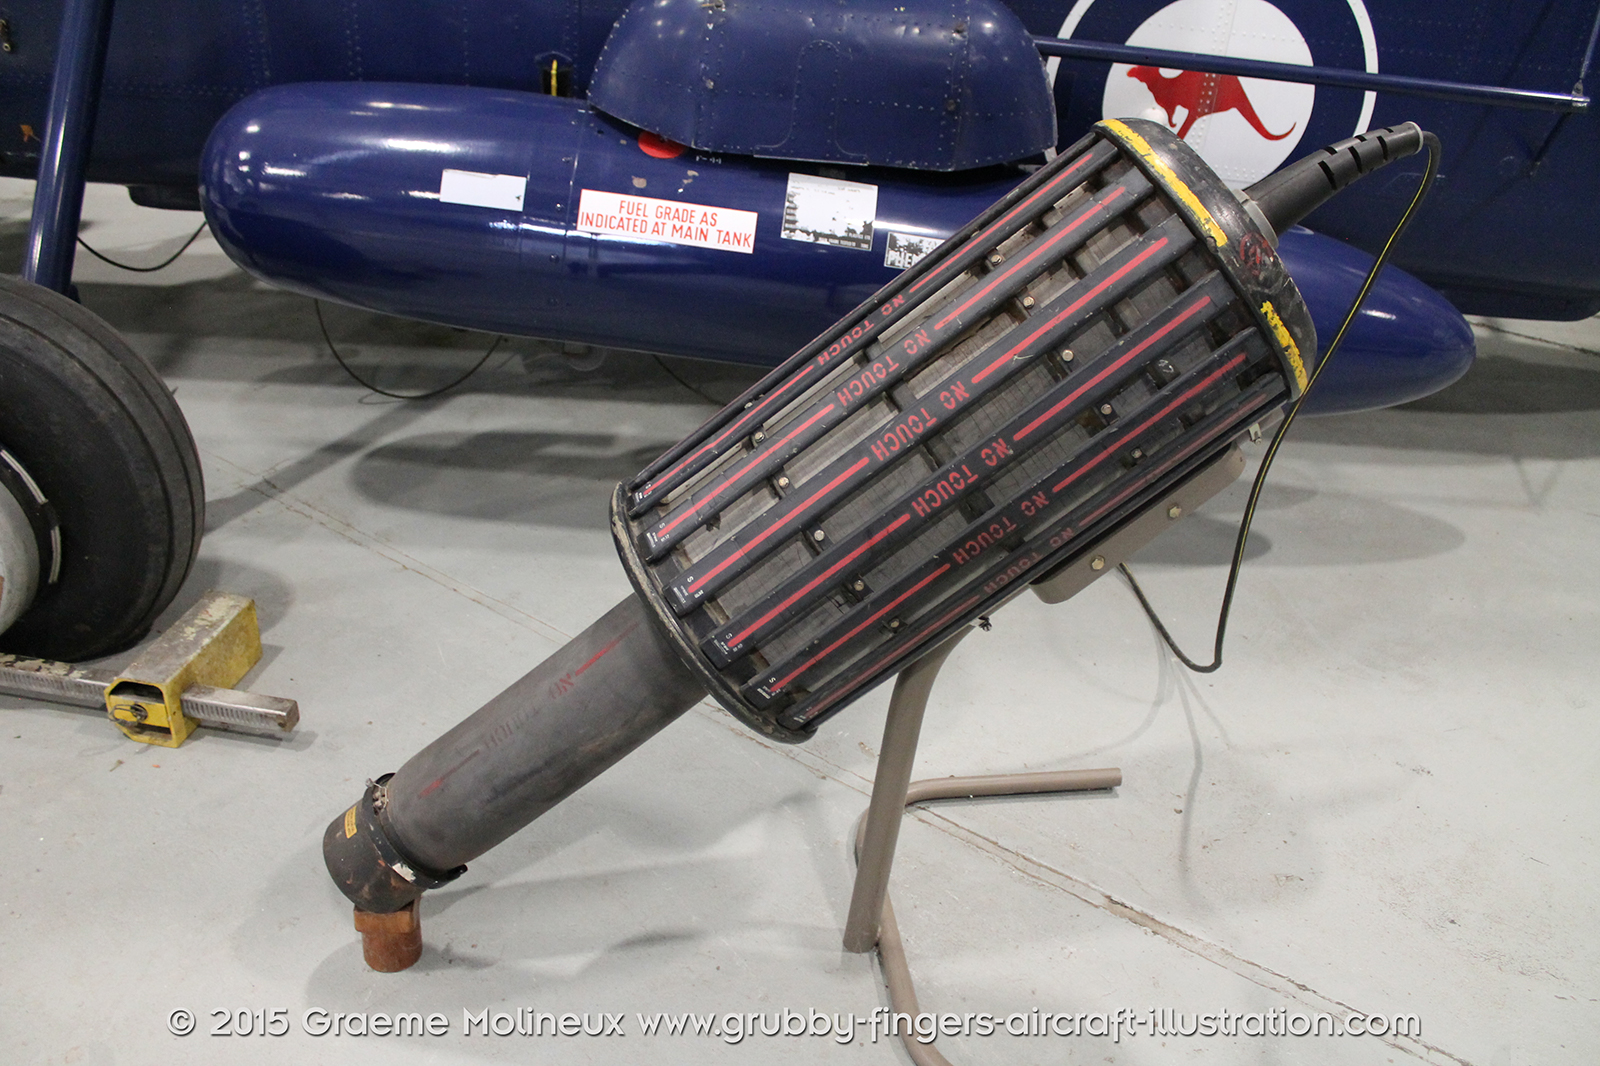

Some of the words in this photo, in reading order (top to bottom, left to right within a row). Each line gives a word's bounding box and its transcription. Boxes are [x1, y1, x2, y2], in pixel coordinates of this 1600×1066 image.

[580, 211, 648, 234] INDICATED
[651, 221, 667, 237] AT
[671, 224, 709, 242] MAIN
[717, 229, 752, 248] TANK
[619, 200, 648, 218] FUEL
[655, 205, 696, 224] GRADE
[699, 211, 718, 227] AS
[881, 294, 905, 315] NO
[817, 320, 875, 365] TOUCH
[904, 329, 931, 354] NO
[837, 355, 899, 406] TOUCH
[939, 381, 970, 410] NO
[870, 407, 937, 461] TOUCH
[980, 438, 1011, 466] NO
[911, 464, 978, 517] TOUCH
[1020, 490, 1049, 516] NO
[952, 516, 1017, 565] TOUCH
[1050, 527, 1075, 548] NO
[983, 551, 1043, 594] TOUCH
